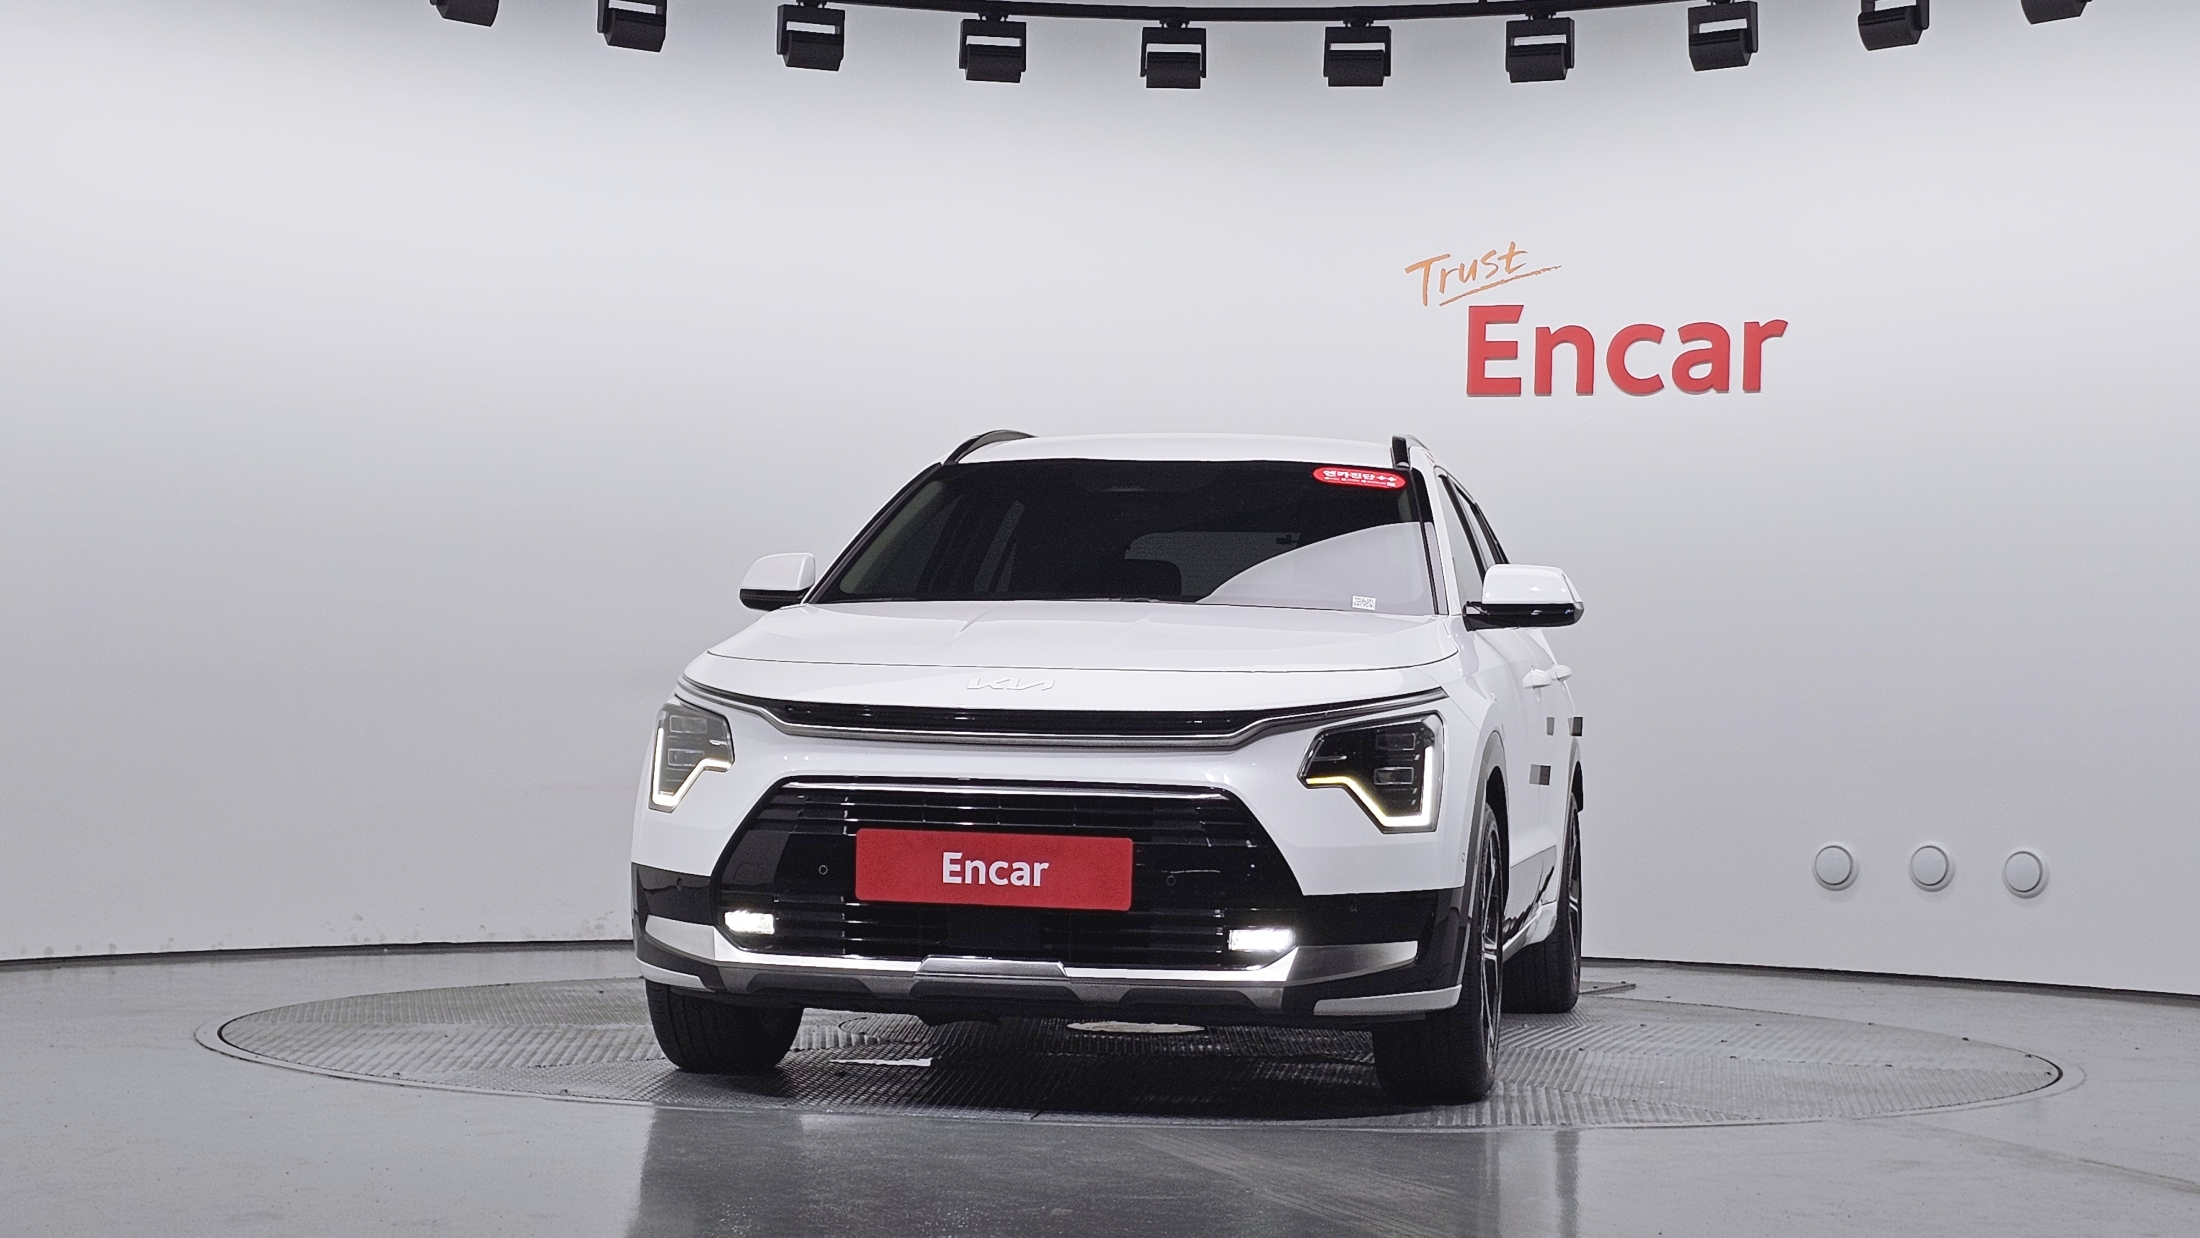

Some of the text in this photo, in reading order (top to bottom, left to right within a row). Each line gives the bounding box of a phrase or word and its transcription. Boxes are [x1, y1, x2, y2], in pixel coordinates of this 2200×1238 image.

[1405, 241, 1528, 306] Trust
[1466, 304, 1788, 397] Encar
[967, 677, 1056, 691] KIA
[943, 852, 1049, 886] Encar
